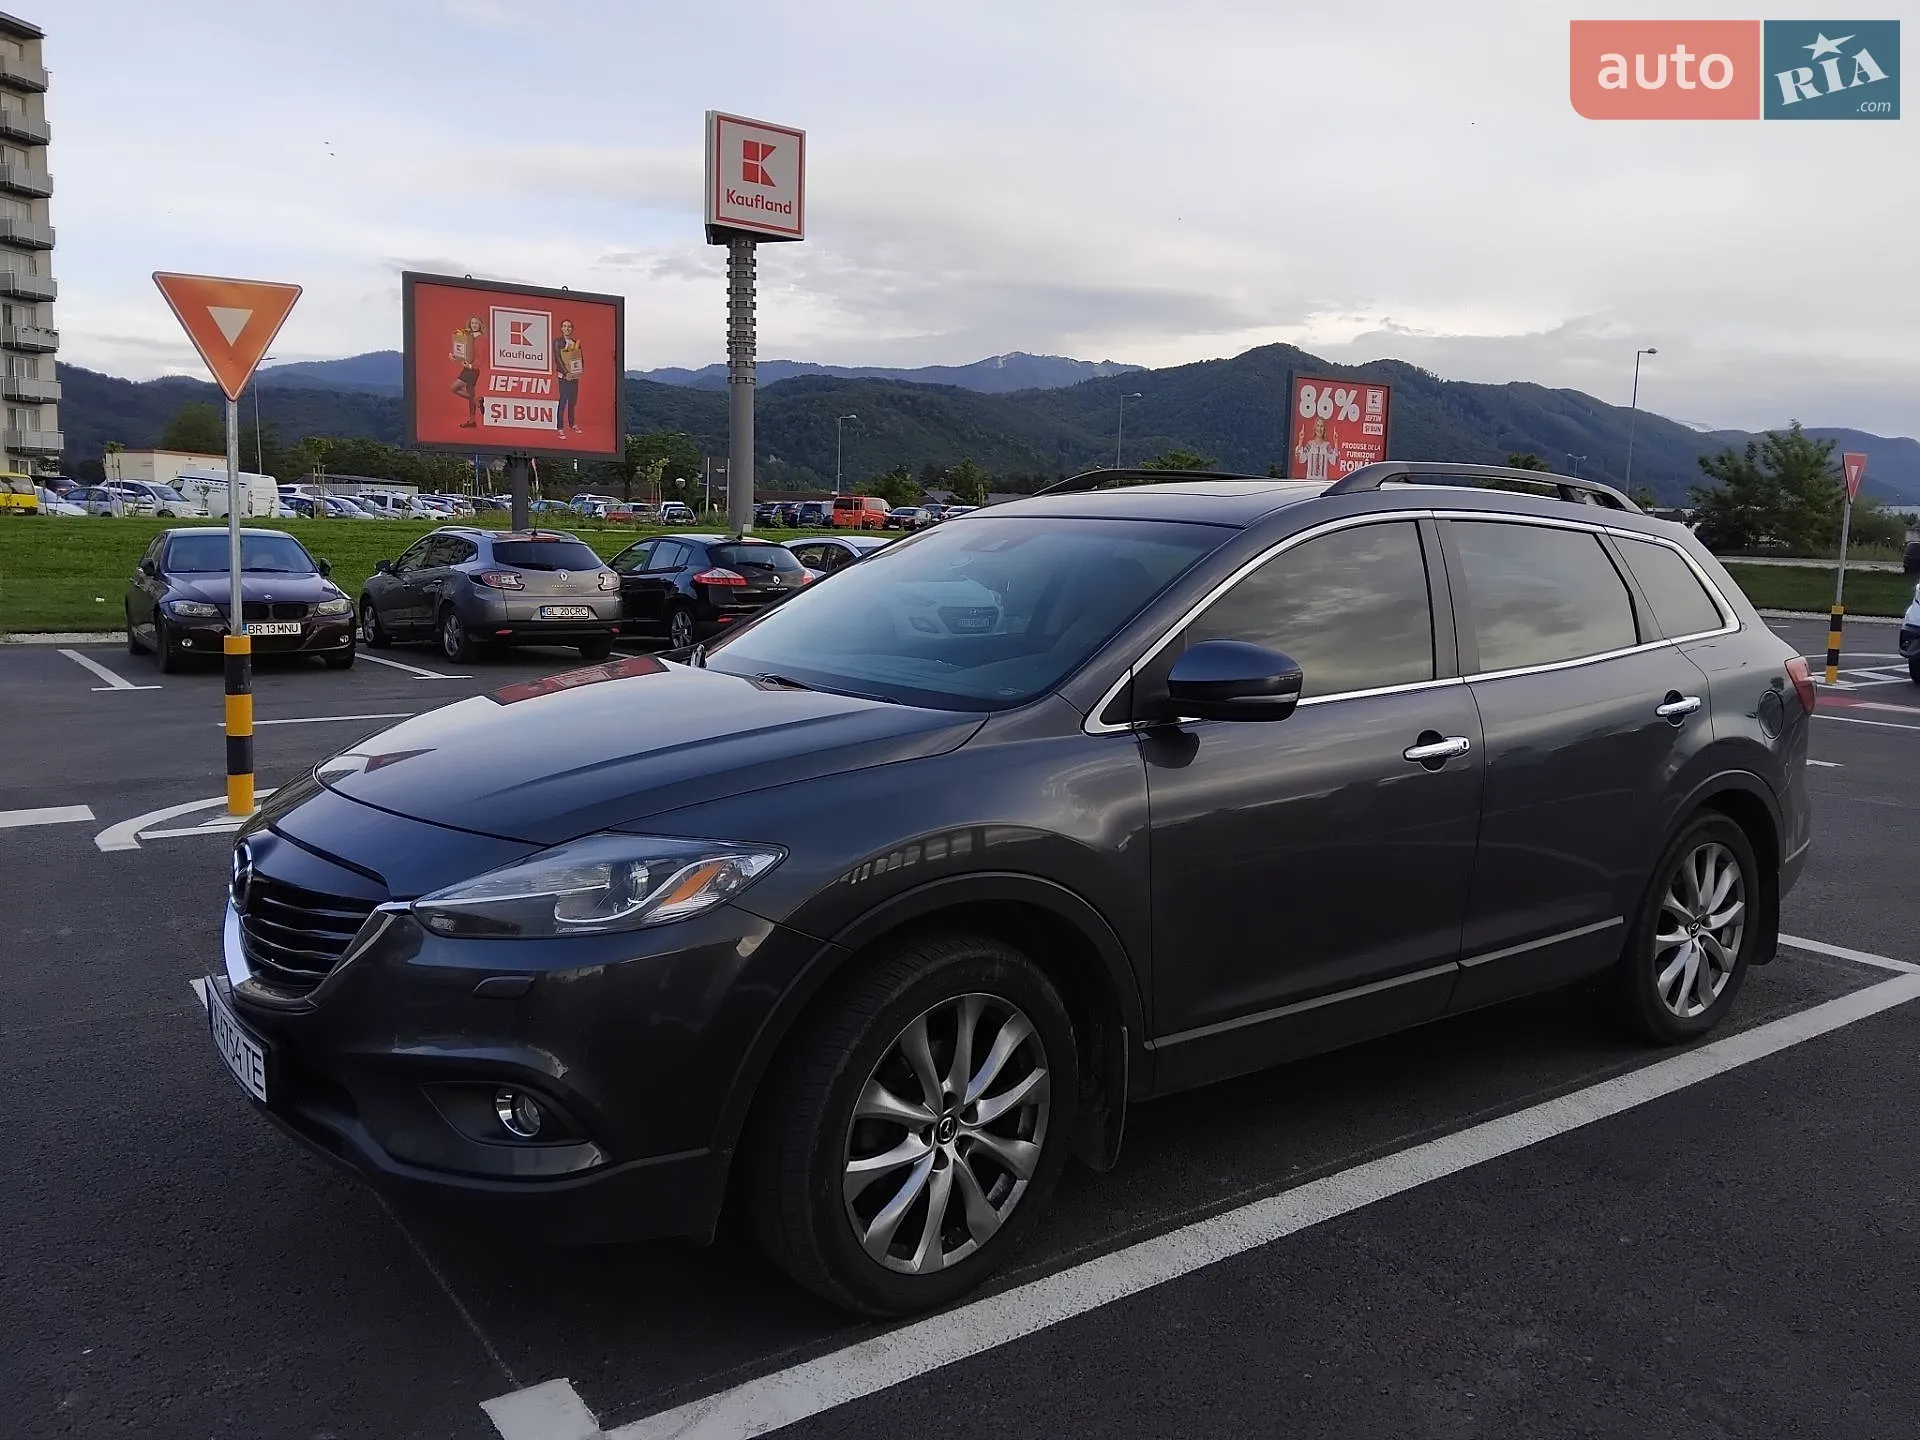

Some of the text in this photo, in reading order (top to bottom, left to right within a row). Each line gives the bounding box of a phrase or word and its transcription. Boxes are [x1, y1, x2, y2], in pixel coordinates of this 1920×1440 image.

[742, 139, 777, 187] K
[726, 188, 792, 215] Kaufland
[499, 349, 544, 362] Kaufland
[488, 374, 552, 395] IEFTIN
[1299, 384, 1360, 422] 86%
[513, 405, 553, 423] BUN
[546, 607, 558, 616] GL
[248, 624, 263, 634] BR
